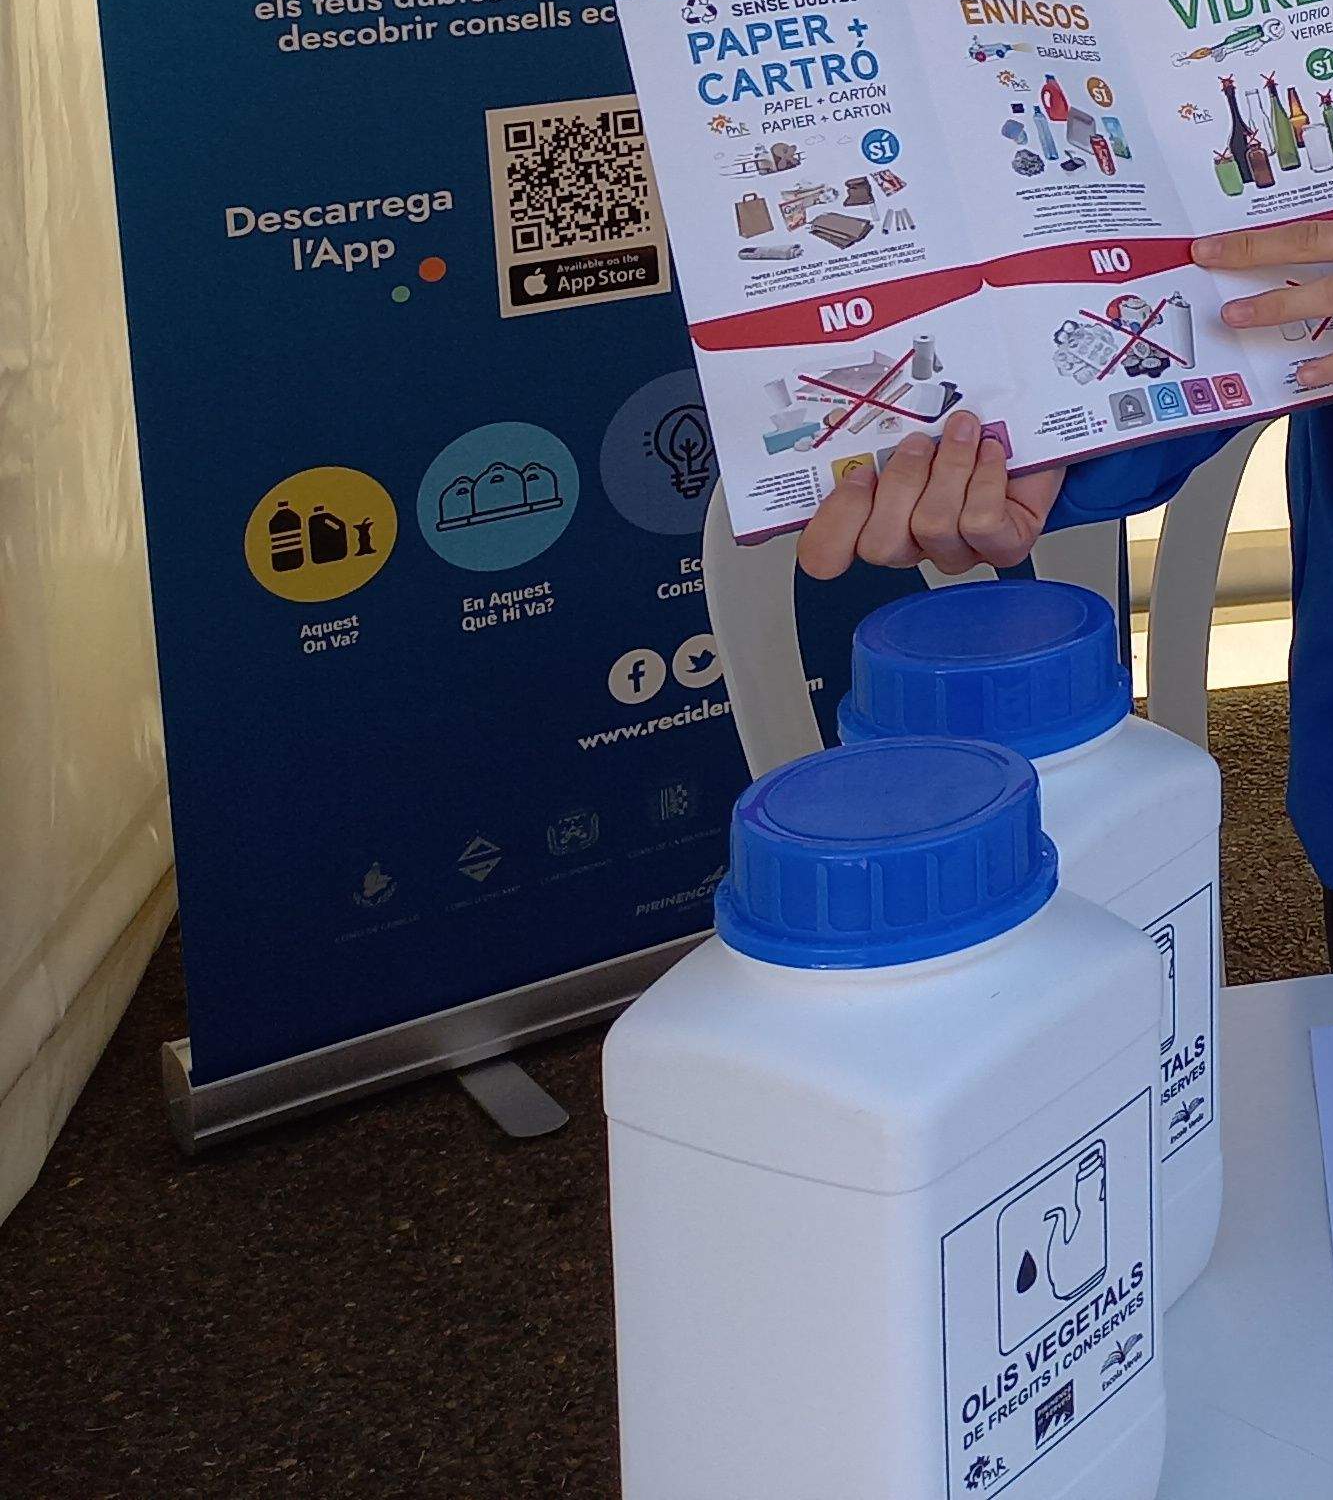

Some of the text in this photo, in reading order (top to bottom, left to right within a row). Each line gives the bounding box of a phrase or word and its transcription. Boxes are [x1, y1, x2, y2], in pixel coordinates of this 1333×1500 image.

[279, 2, 616, 52] descobrir consells ec
[1288, 6, 1330, 25] VIDRIO
[1291, 23, 1333, 40] VERRE
[687, 14, 834, 65] PAPER
[1037, 47, 1101, 61] EMBALLAGES
[1053, 33, 1096, 46] ENVASES
[698, 38, 879, 106] CARTRÓ
[764, 99, 812, 115] PAPEL
[828, 83, 886, 105] CARTÓN
[762, 114, 816, 134] PAPIER
[832, 102, 891, 122] CARTON
[225, 190, 453, 238] Descarrega
[293, 236, 395, 272] l'App
[556, 253, 639, 274] Available on the
[1089, 247, 1131, 274] NO
[557, 264, 646, 293] App Store
[819, 298, 874, 333] NO
[680, 558, 704, 574] Ec
[462, 581, 551, 613] En Aquest
[657, 578, 704, 601] Cons
[300, 614, 359, 641] Aquest
[462, 597, 555, 633] Què Hi Va?
[303, 630, 360, 655] On Va?
[578, 700, 733, 751] www.recicle
[1161, 1035, 1205, 1083] TALS
[962, 1363, 1018, 1424] OLIS
[1026, 1261, 1143, 1372] VEGETALS
[964, 1423, 985, 1450] DE
[988, 1371, 1051, 1431] FREGITS
[1055, 1363, 1060, 1379] I
[1063, 1292, 1143, 1371] CONSERVES
